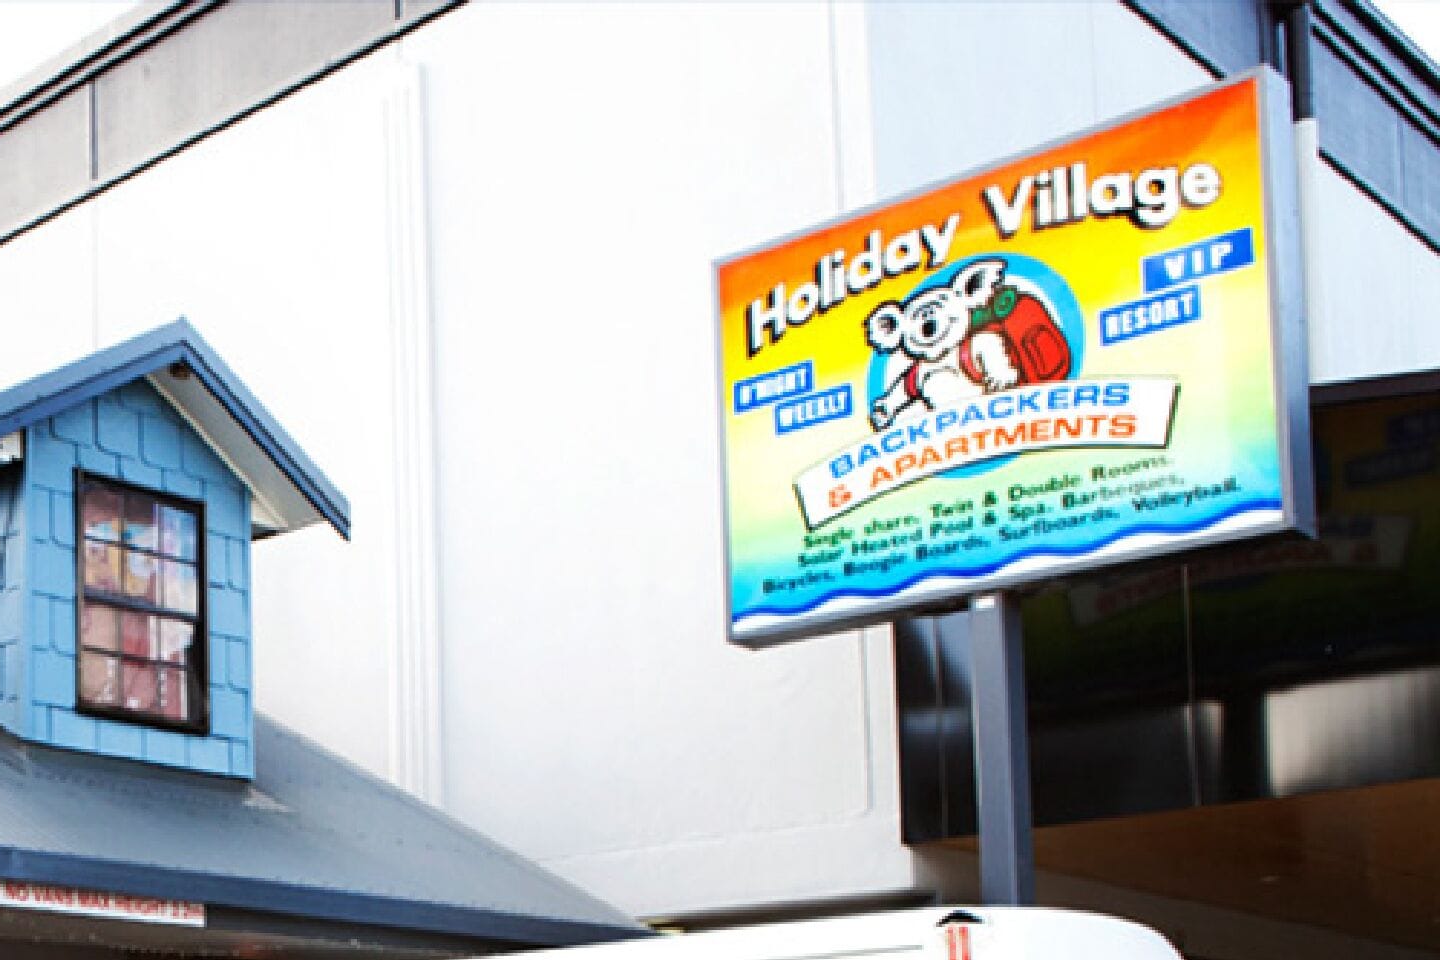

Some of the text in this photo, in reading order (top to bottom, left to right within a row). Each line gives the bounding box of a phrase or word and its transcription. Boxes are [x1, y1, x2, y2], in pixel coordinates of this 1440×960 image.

[747, 161, 1222, 358] Holiday Village
[1164, 239, 1235, 281] VIP
[1102, 289, 1196, 341] RESORT
[779, 391, 846, 427] WEEKLY
[828, 382, 1131, 479] BACKPACKERS
[827, 414, 1137, 509] & APARTMENTS
[803, 527, 854, 549] Single
[931, 498, 973, 518] Twin
[983, 489, 998, 507] &
[1008, 473, 1082, 501] Double
[798, 549, 844, 568] Solar
[851, 528, 923, 555] Heated
[930, 516, 974, 538] Pool
[983, 510, 997, 527] &
[843, 553, 907, 577] Boogie
[5, 881, 28, 902] NO
